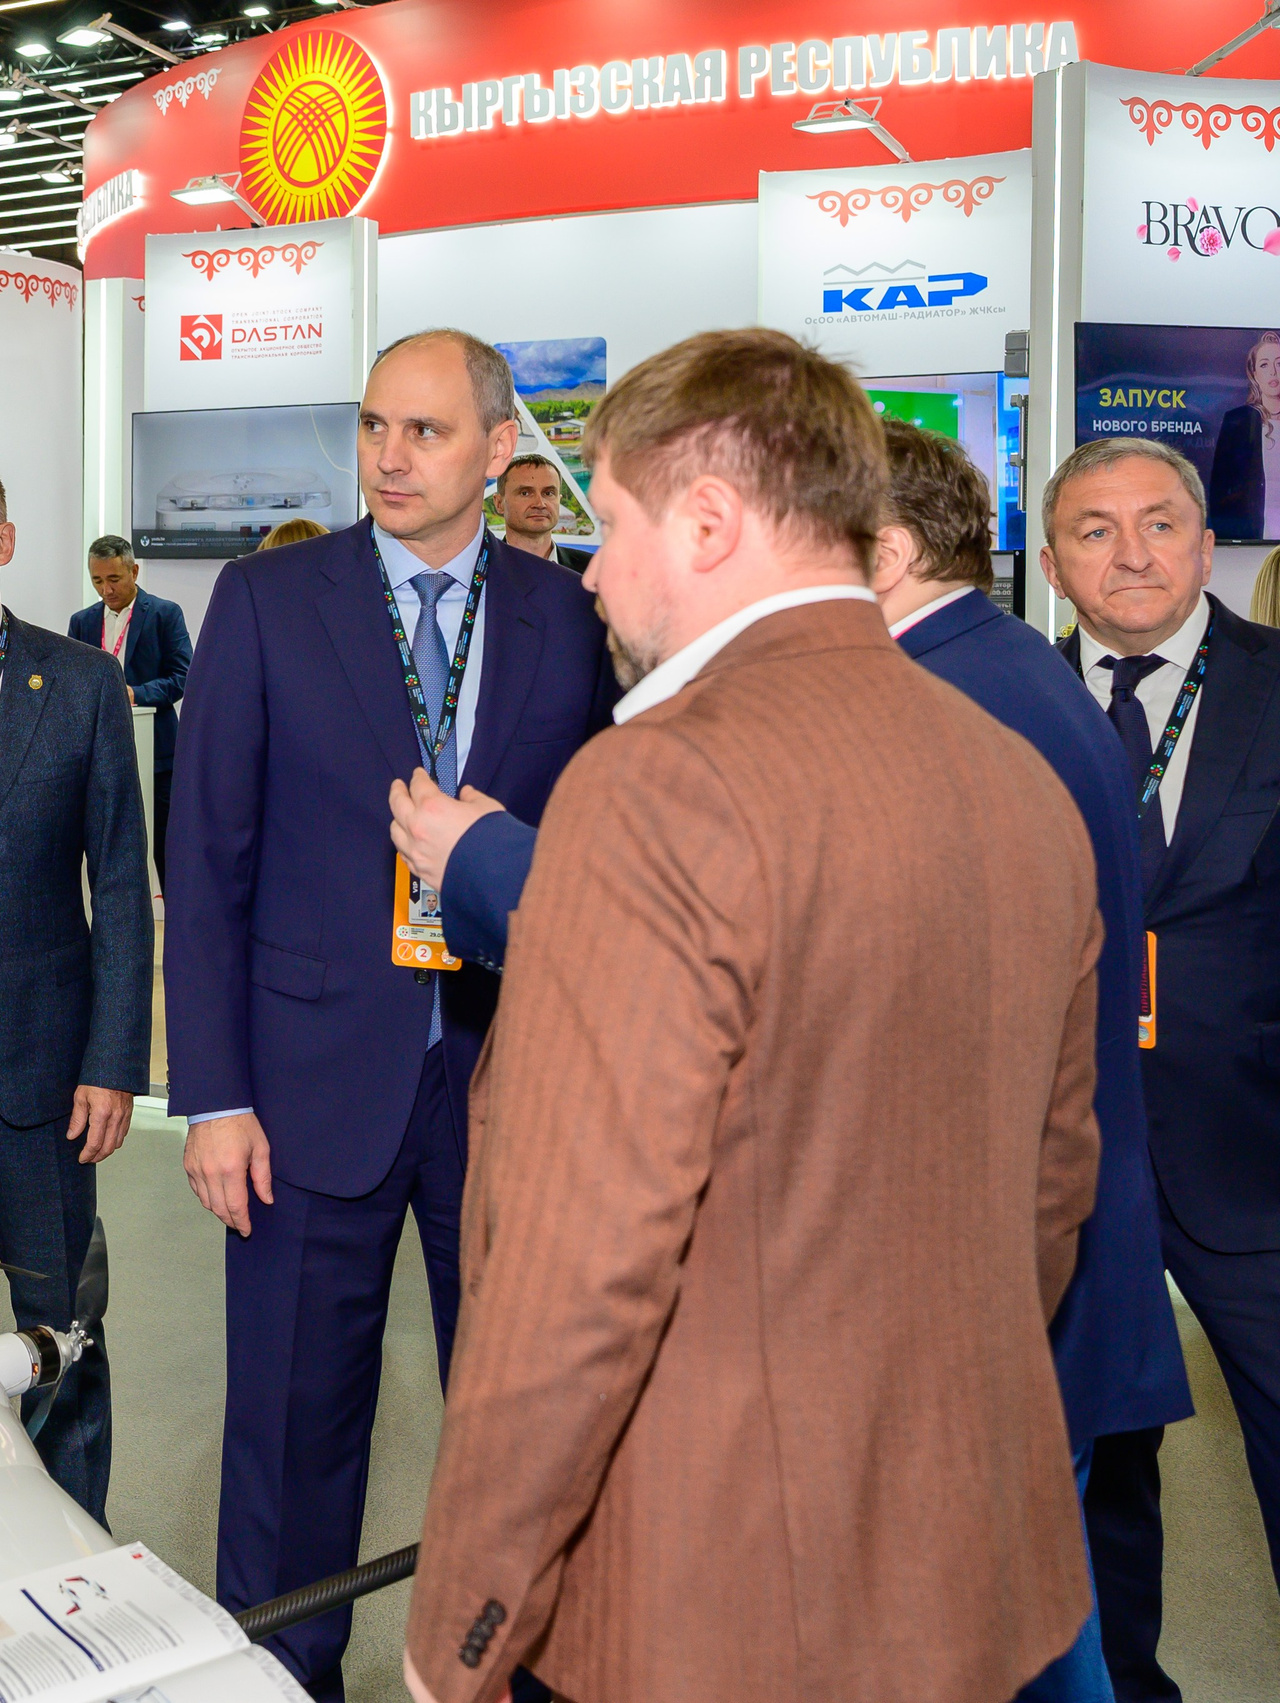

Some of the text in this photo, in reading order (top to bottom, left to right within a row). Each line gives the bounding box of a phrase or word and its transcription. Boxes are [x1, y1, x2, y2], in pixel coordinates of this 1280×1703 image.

[410, 21, 1081, 140] КЫРГЫЗСКАЯ РЕСПУБЛИКА
[1142, 201, 1280, 256] BRAVO
[804, 306, 1006, 326] ОсОО «АВТОМАШ-РАДИАТОР» ЖЧКсы
[231, 322, 323, 344] DASTAN
[1099, 388, 1187, 409] ЗАПУСК
[1092, 419, 1203, 434] НОВОГО БРЕНДА
[420, 948, 428, 958] 2
